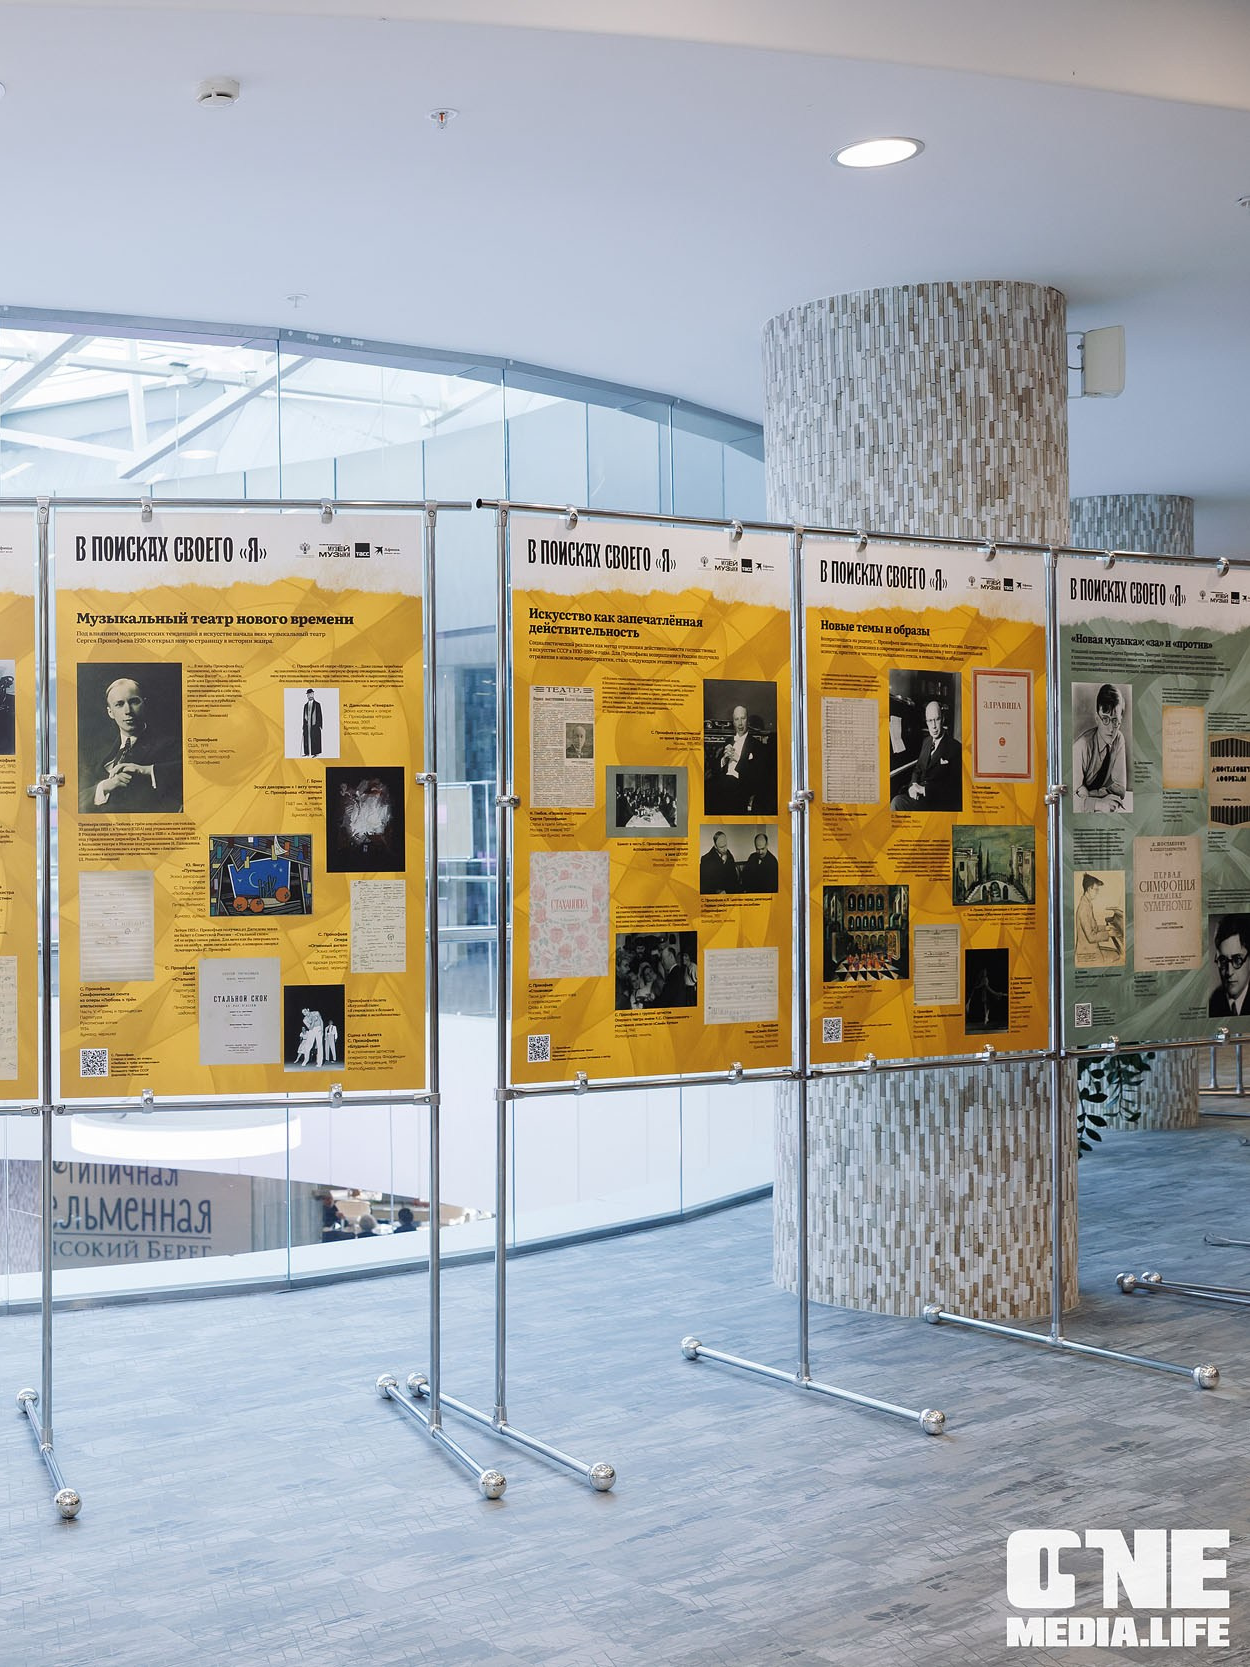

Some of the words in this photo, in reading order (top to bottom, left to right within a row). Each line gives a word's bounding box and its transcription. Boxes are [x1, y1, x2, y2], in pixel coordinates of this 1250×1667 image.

[75, 535, 86, 561] В
[91, 535, 168, 561] ПОИСКАХ
[173, 536, 233, 562] СВОЕГО
[239, 537, 267, 562] «Я»
[527, 538, 536, 563] В
[540, 539, 600, 568] ПОИСКАХ
[604, 544, 650, 571] СВОЕГО
[655, 547, 677, 573] «Я»
[820, 559, 827, 583] В
[831, 560, 882, 587] ПОИСКАХ
[886, 564, 925, 590] СВОЕГО
[929, 568, 948, 591] «Я»
[1070, 577, 1077, 600] В
[1079, 577, 1127, 603] ПОИСКАХ
[1129, 581, 1166, 606] СВОЕГО
[1169, 584, 1186, 607] «Я»
[76, 612, 188, 626] Музыкальный
[190, 616, 233, 627] театр
[236, 616, 288, 624] нового
[290, 616, 354, 627] времени
[528, 607, 592, 626] Искусство
[593, 613, 615, 622] как
[617, 612, 703, 627] запечатлённая
[529, 623, 639, 637] действительность
[821, 619, 854, 631] Новые
[856, 624, 883, 633] темы
[893, 624, 930, 638] образы
[1071, 633, 1103, 644] «Новая
[1104, 637, 1144, 648] музыка»:
[1172, 640, 1212, 651] «против»
[1139, 879, 1196, 893] СИМФОНИЯ
